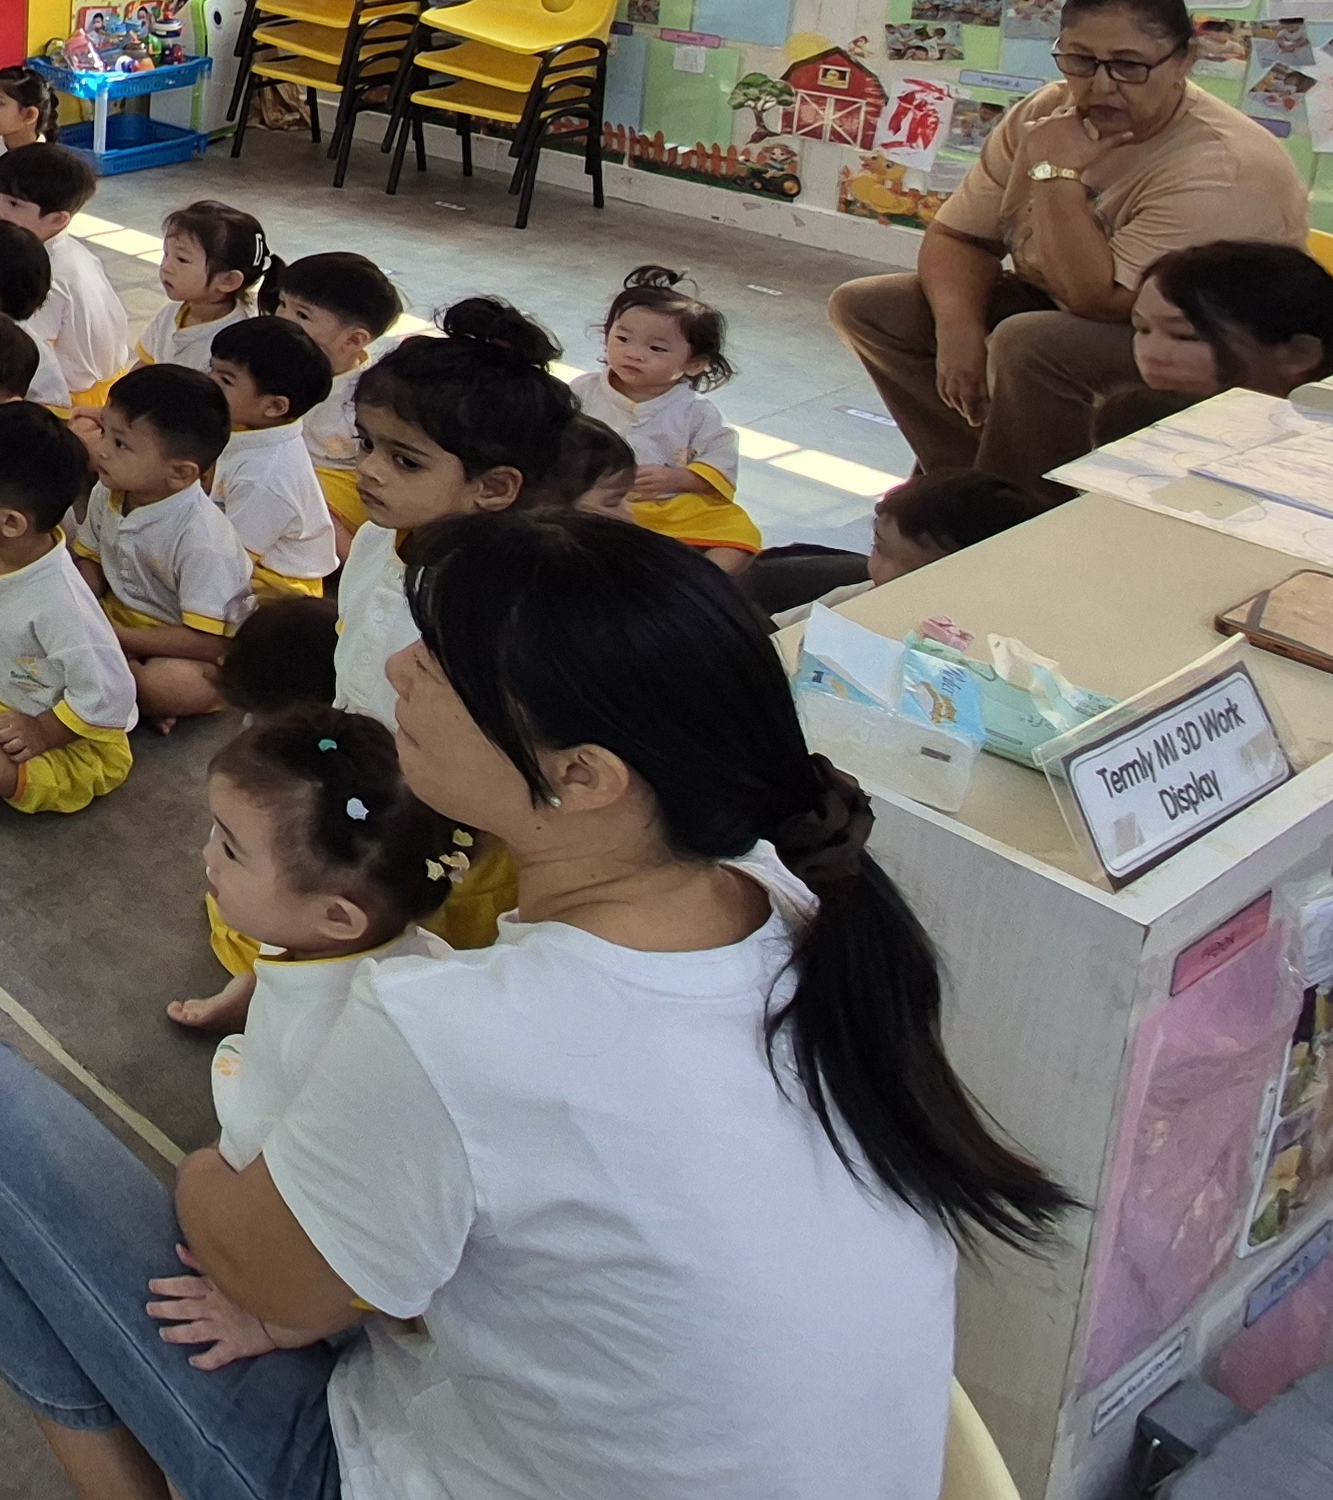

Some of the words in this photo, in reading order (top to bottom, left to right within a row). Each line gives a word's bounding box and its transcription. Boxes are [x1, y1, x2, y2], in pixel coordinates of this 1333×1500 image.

[1095, 747, 1157, 798] Termly
[1176, 720, 1202, 756] 3D
[1198, 697, 1247, 743] Work
[1157, 770, 1223, 821] Display
